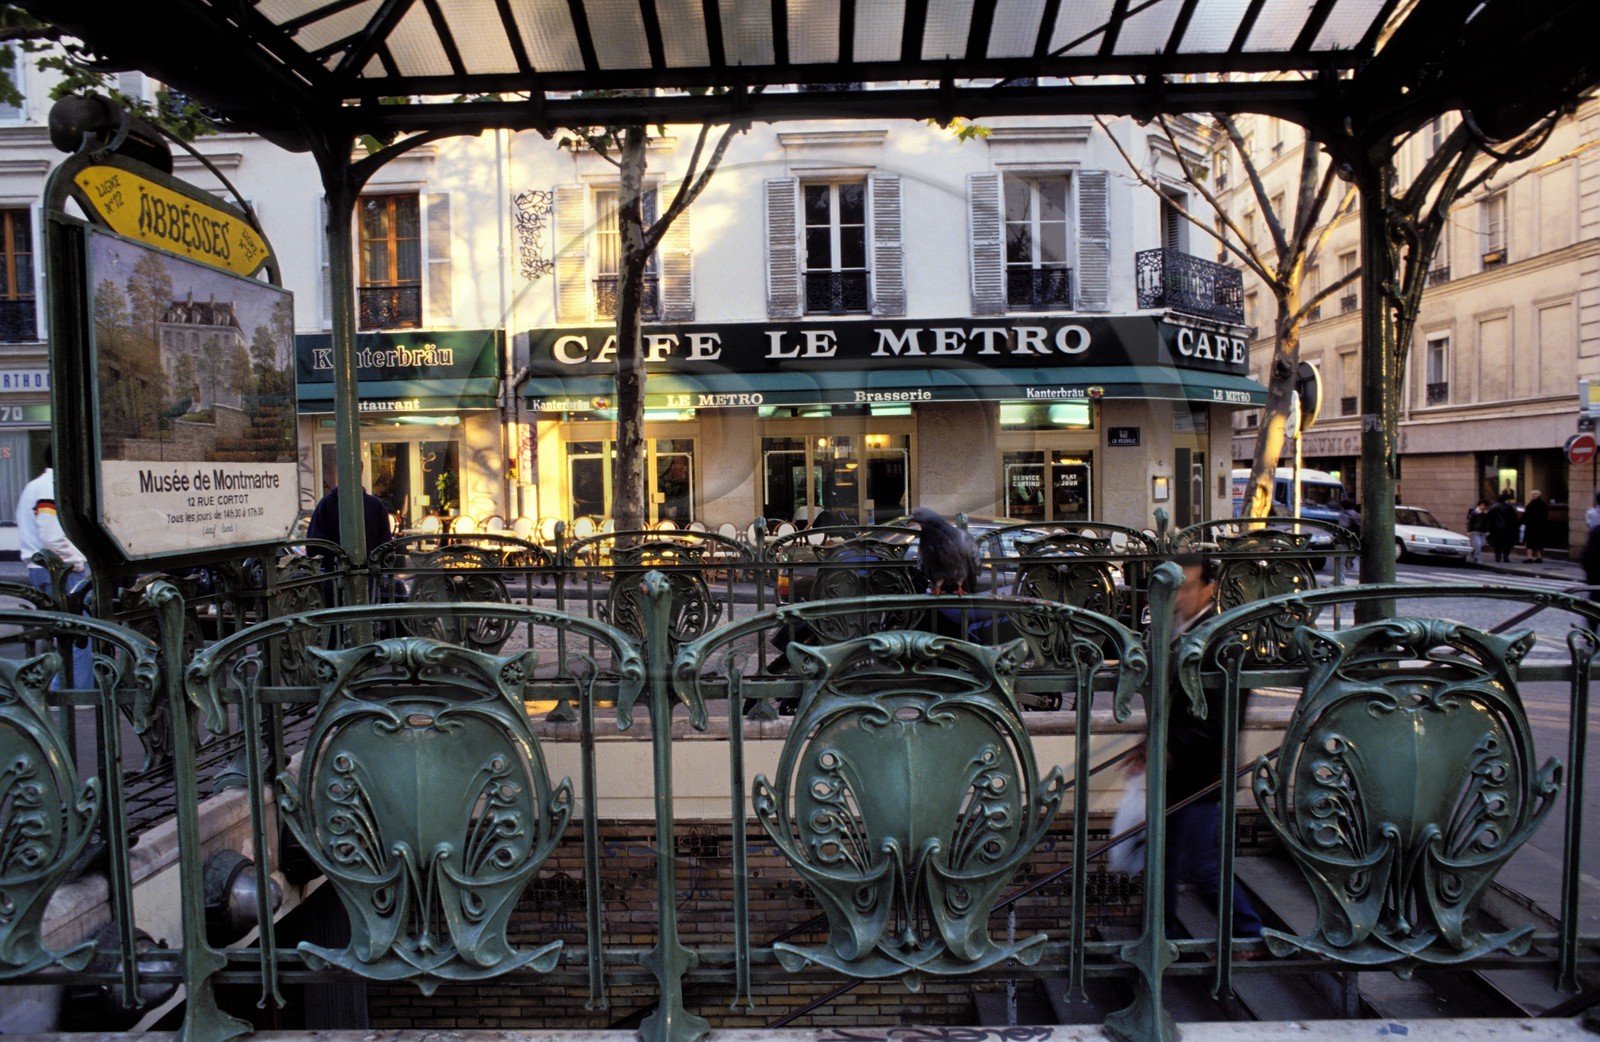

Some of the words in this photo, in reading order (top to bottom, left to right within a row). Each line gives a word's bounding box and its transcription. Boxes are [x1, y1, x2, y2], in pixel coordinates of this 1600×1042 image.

[95, 174, 121, 198] LIGNE
[764, 330, 838, 359] LE
[870, 325, 1092, 357] METRO
[1177, 327, 1246, 364] CAFE
[312, 343, 454, 370] Kterbräu
[854, 388, 932, 402] Brasserie
[1026, 387, 1085, 398] Kanterbräu
[1213, 388, 1223, 400] LE
[1225, 391, 1251, 403] METRO
[358, 399, 420, 411] staurant
[532, 398, 590, 411] Kanterbräu
[667, 394, 690, 407] LE
[698, 393, 764, 406] METRO
[1, 406, 23, 422] 70
[139, 469, 189, 493] Musée
[193, 470, 211, 490] de
[213, 469, 280, 490] Montmartre
[1012, 474, 1041, 482] SERVICE
[1061, 473, 1078, 481] PLAT
[187, 497, 196, 507] 12
[197, 496, 215, 506] RUE
[217, 494, 249, 505] CORTOT
[167, 514, 183, 524] Tous
[185, 512, 195, 522] les
[196, 511, 212, 523] jours
[213, 510, 222, 520] de
